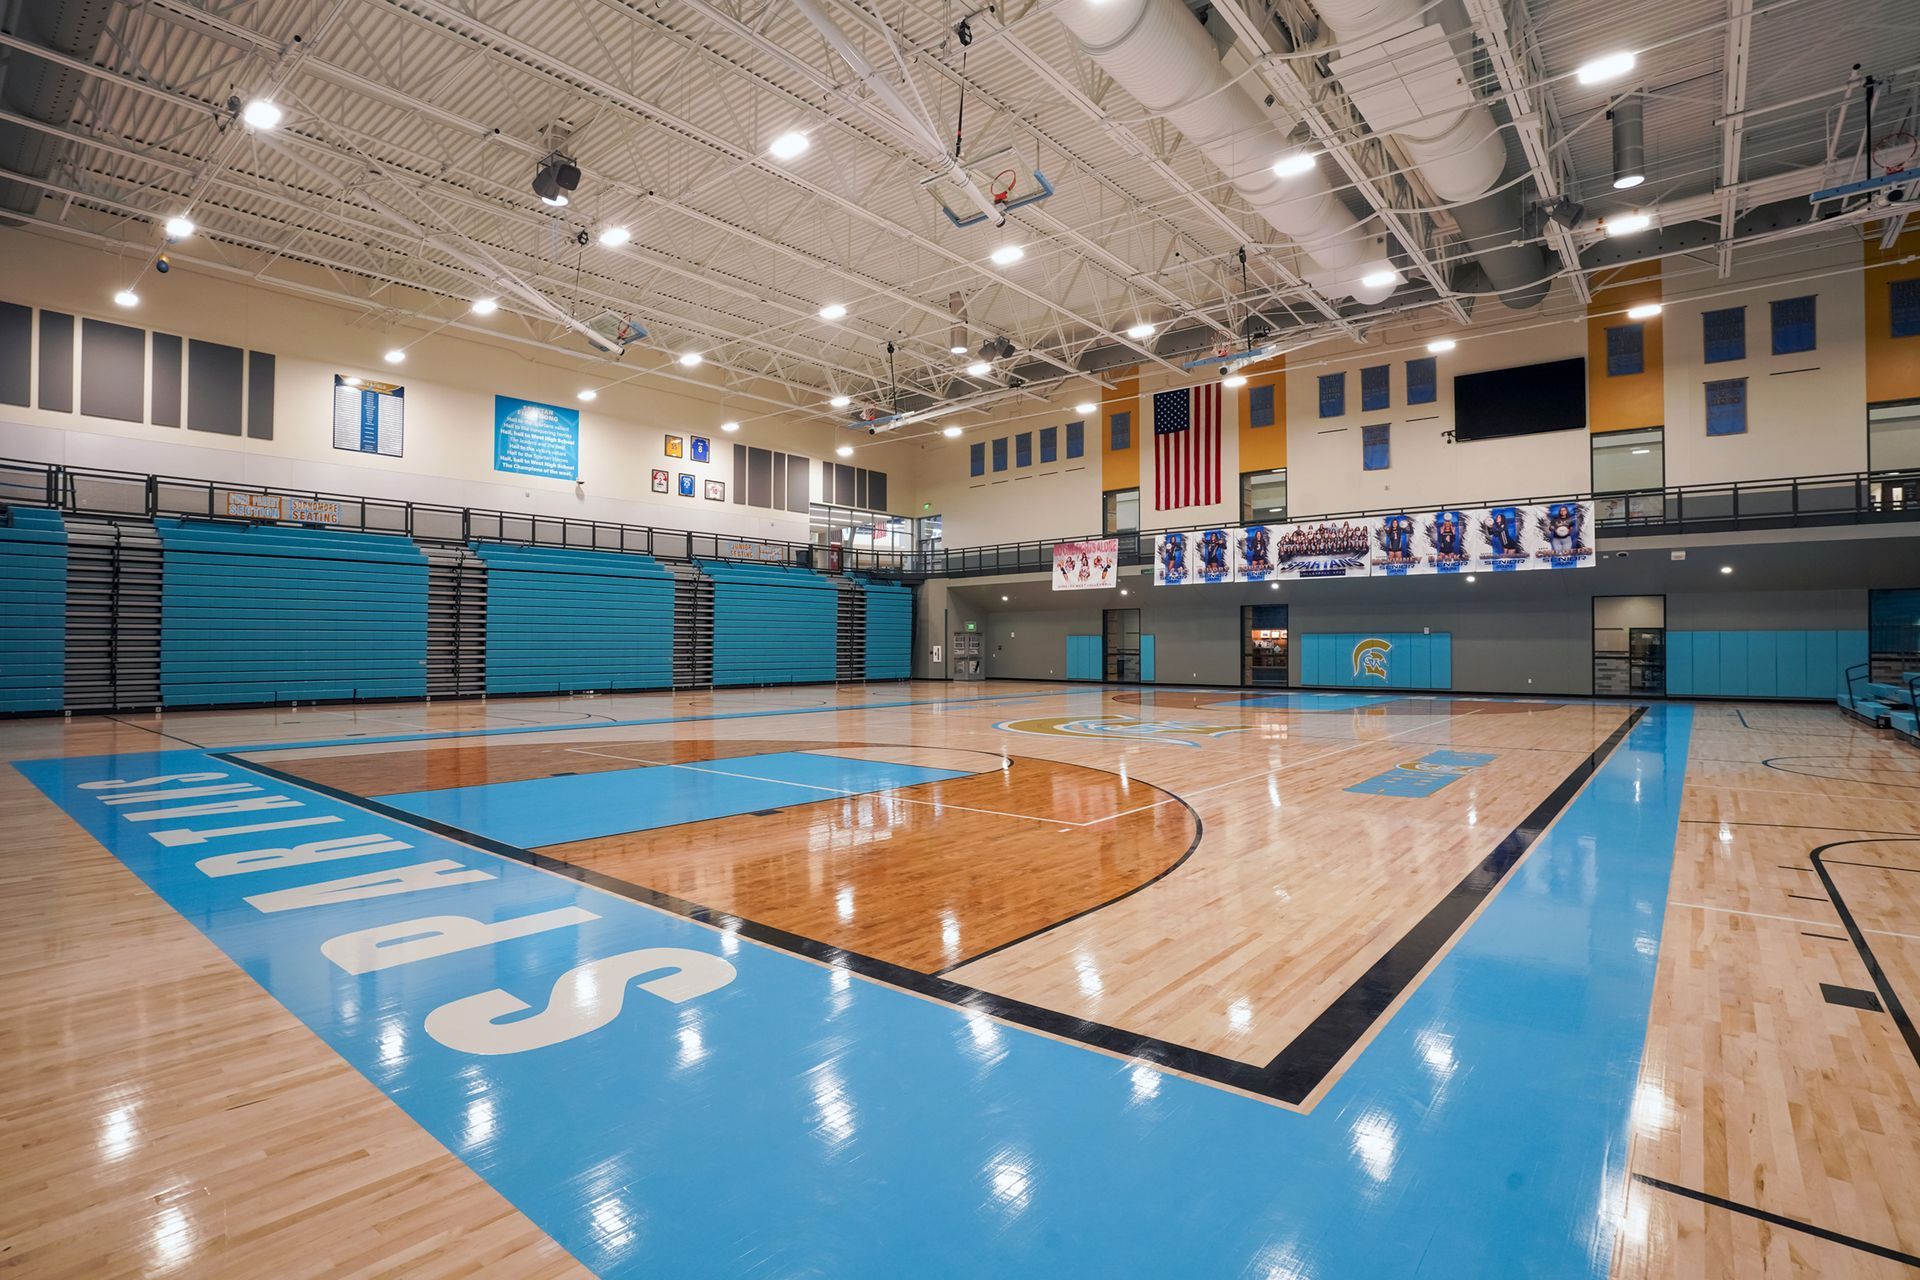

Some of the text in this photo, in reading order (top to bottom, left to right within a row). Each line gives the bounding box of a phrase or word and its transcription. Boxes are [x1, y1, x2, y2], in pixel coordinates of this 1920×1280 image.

[513, 464, 542, 472] Champions
[230, 504, 280, 518] SECTION
[292, 500, 337, 512] SOPHOMORE
[292, 510, 337, 522] SEATING
[1280, 556, 1365, 570] SPARTANS
[78, 771, 738, 1055] SPARTANS
